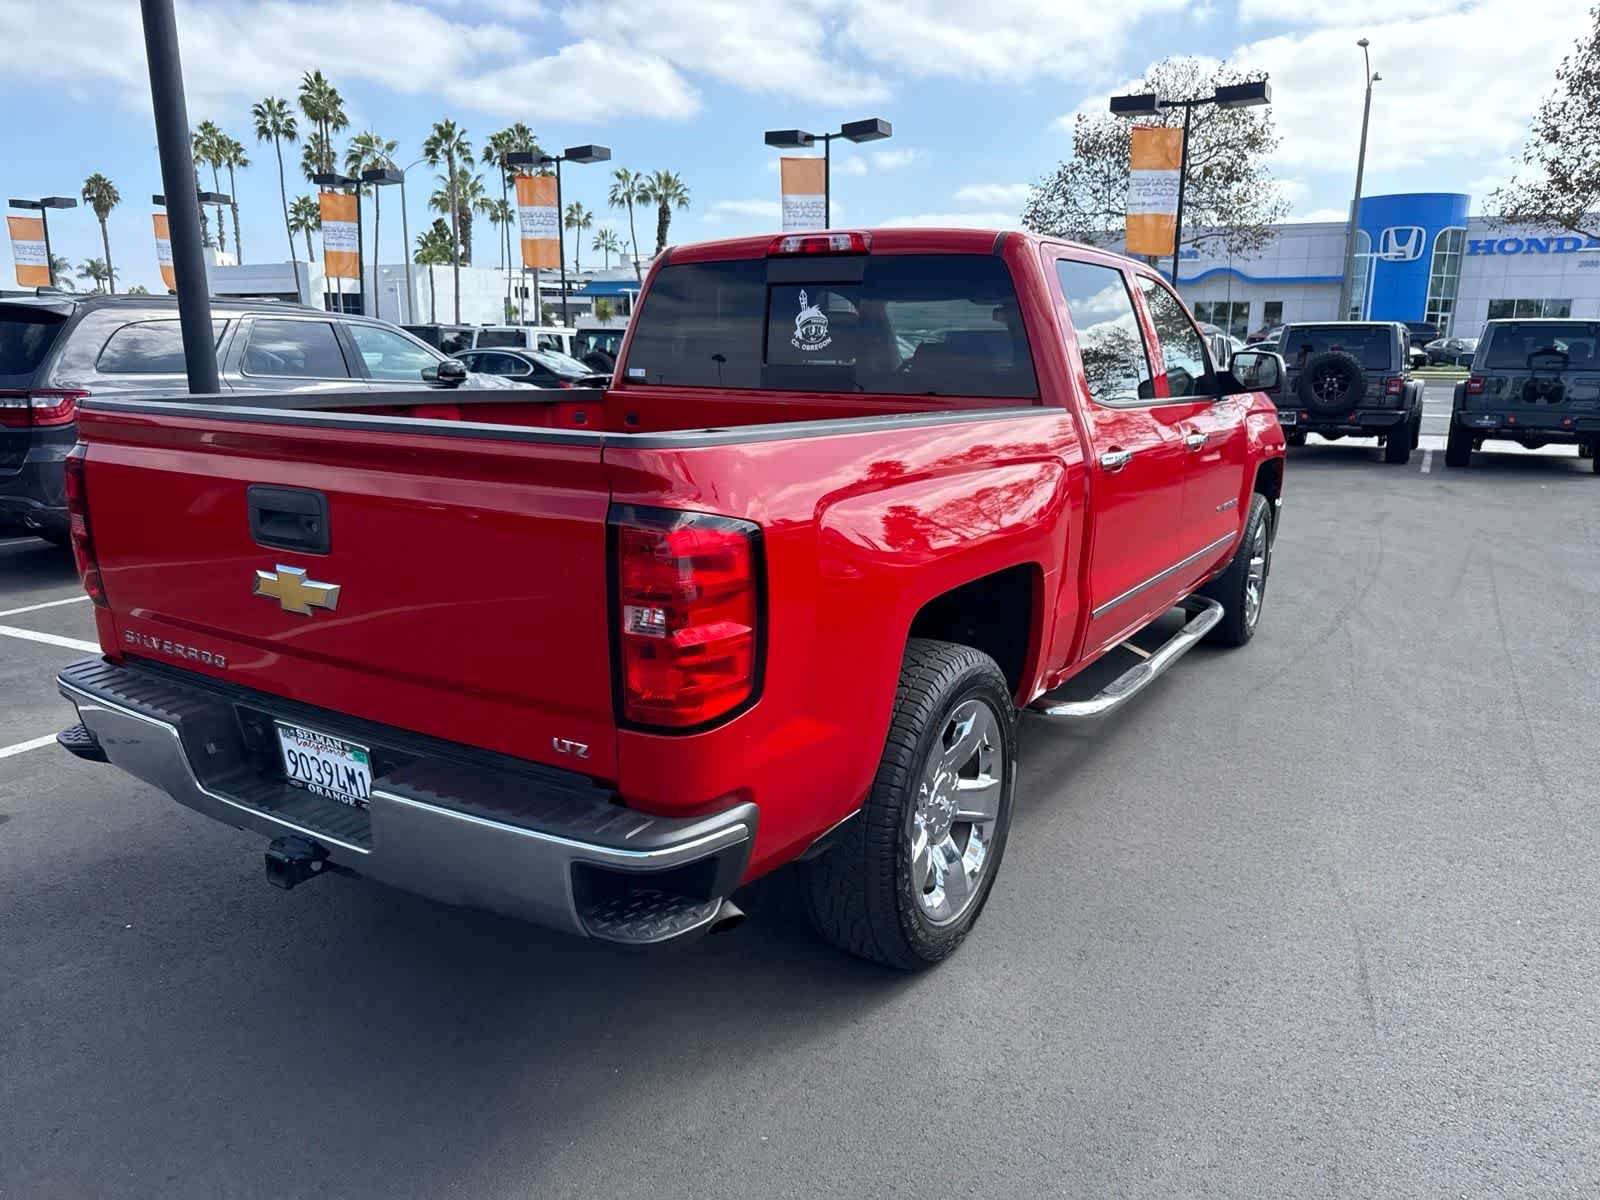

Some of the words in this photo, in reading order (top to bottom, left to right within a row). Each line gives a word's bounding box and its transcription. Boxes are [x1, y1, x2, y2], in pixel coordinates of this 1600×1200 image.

[125, 630, 225, 669] SILVERADO
[295, 729, 344, 750] SELMAN
[553, 737, 589, 759] LTZ
[308, 785, 358, 807] ORANGE
